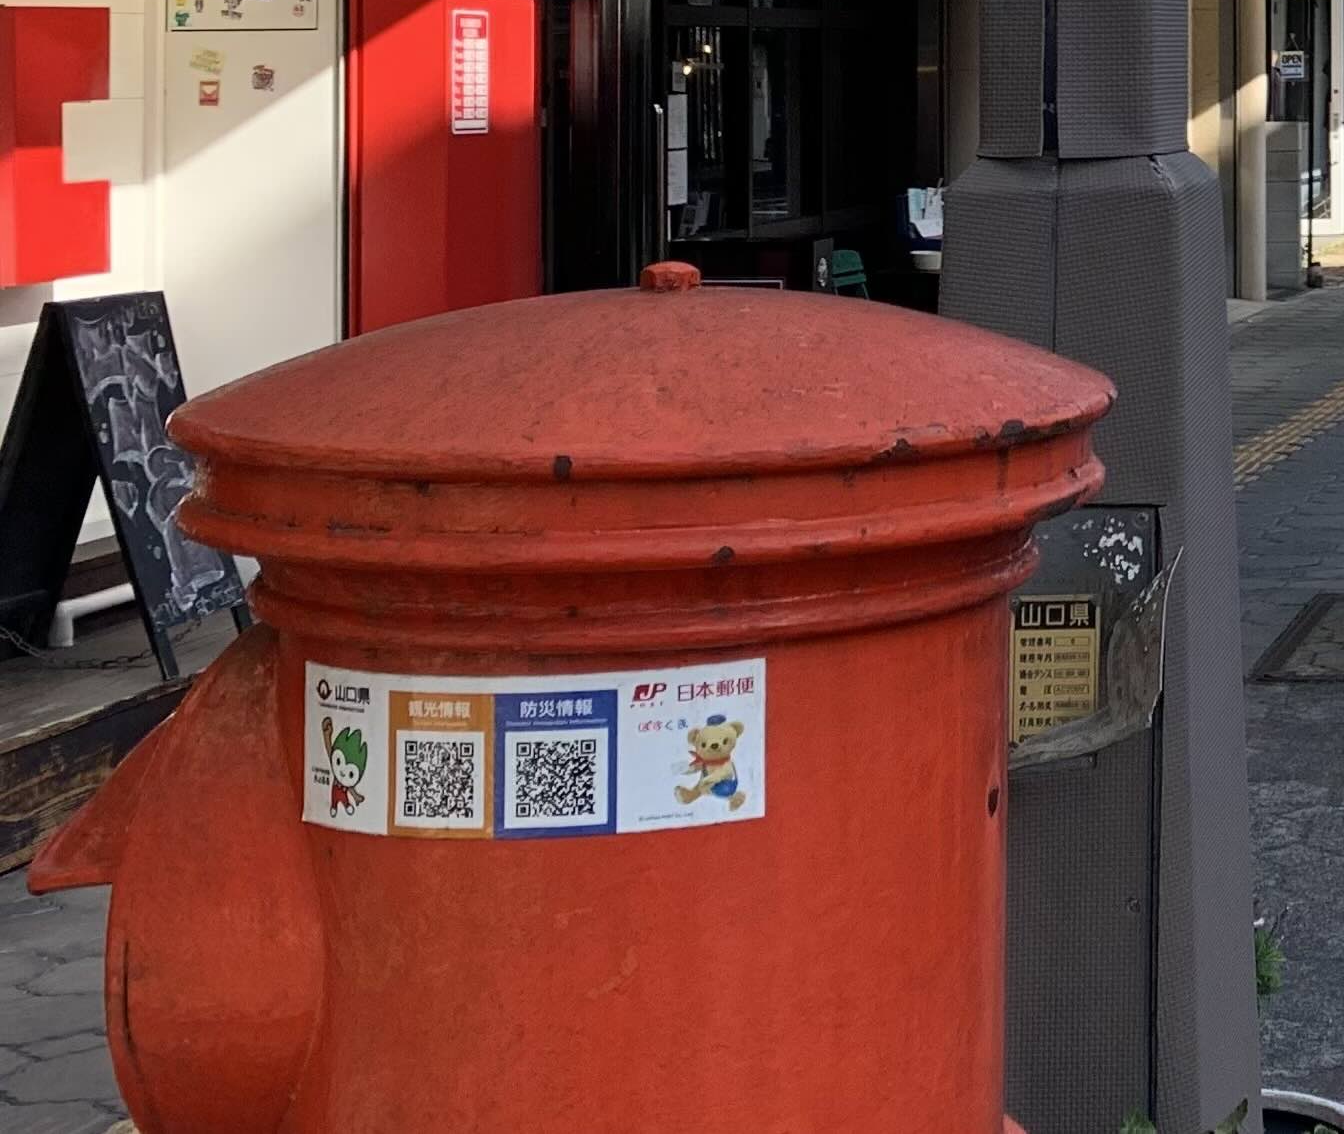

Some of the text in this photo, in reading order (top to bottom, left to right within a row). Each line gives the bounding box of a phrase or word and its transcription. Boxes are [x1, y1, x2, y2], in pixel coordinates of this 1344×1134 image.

[1020, 603, 1090, 627] 山口県
[334, 685, 370, 705] 山口県
[677, 677, 754, 702] 日本郵便
[409, 700, 471, 718] 観光情報
[519, 699, 593, 719] 防災情報
